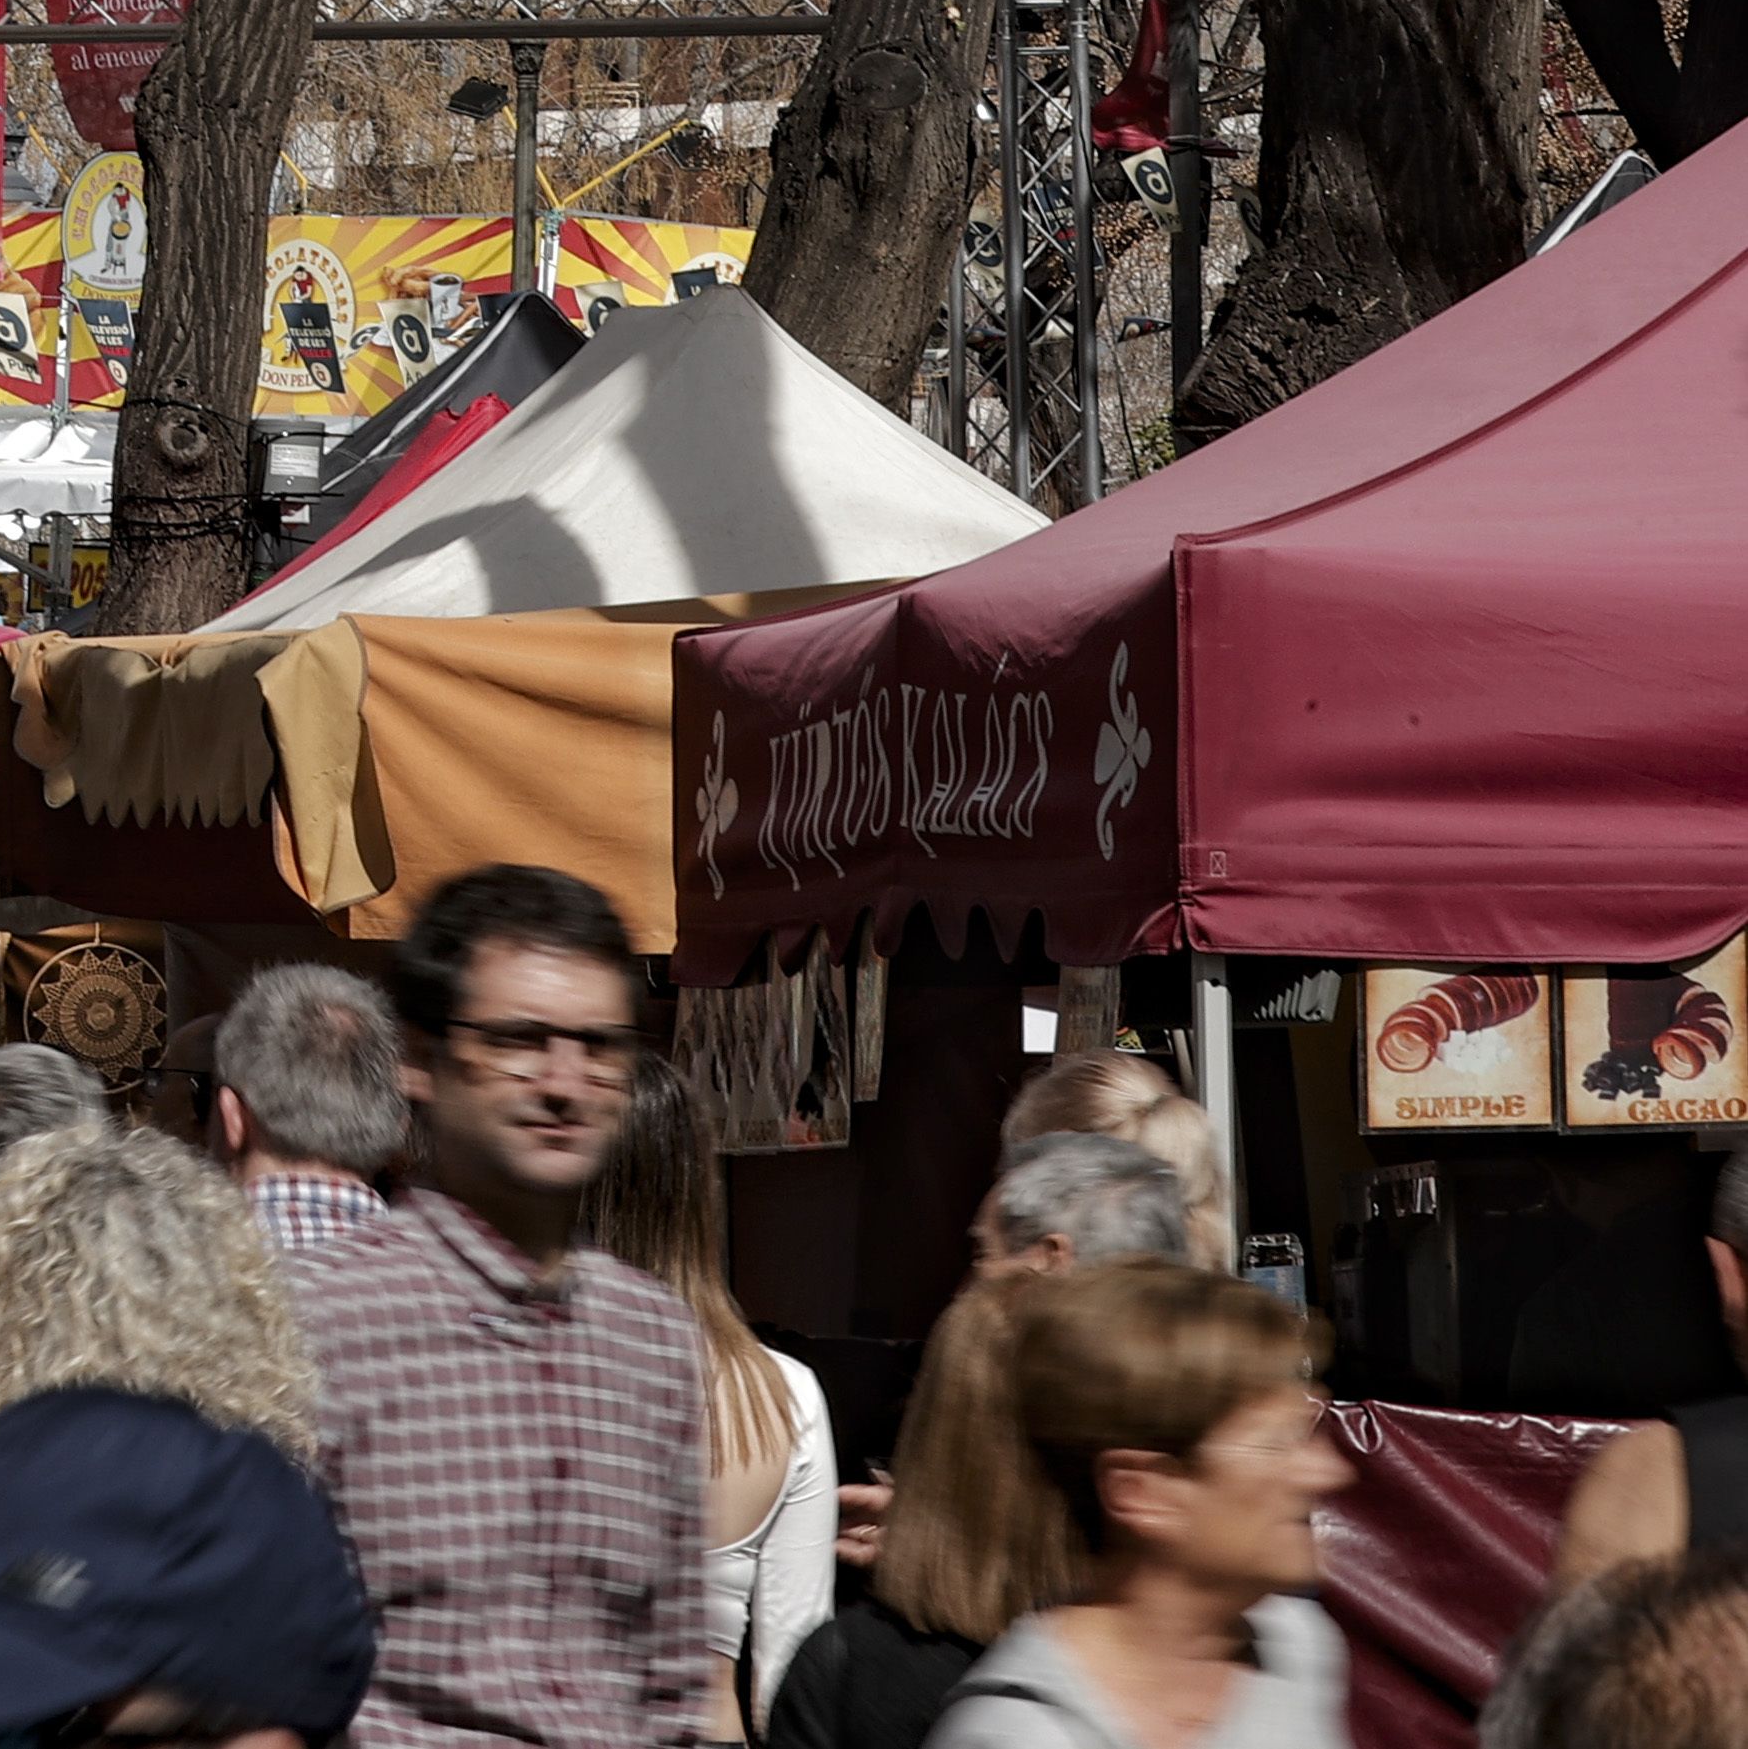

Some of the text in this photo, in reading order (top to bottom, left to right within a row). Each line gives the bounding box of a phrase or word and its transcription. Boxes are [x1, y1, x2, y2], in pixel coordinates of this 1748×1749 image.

[71, 45, 90, 71] al
[98, 315, 111, 325] LA
[303, 318, 314, 327] LA
[289, 325, 332, 338] TELEVISIÓ
[399, 319, 424, 354] à
[311, 339, 327, 349] LES
[262, 369, 287, 386] DON
[1395, 1094, 1527, 1120] SIMPLE
[1627, 1098, 1748, 1122] CACAO
